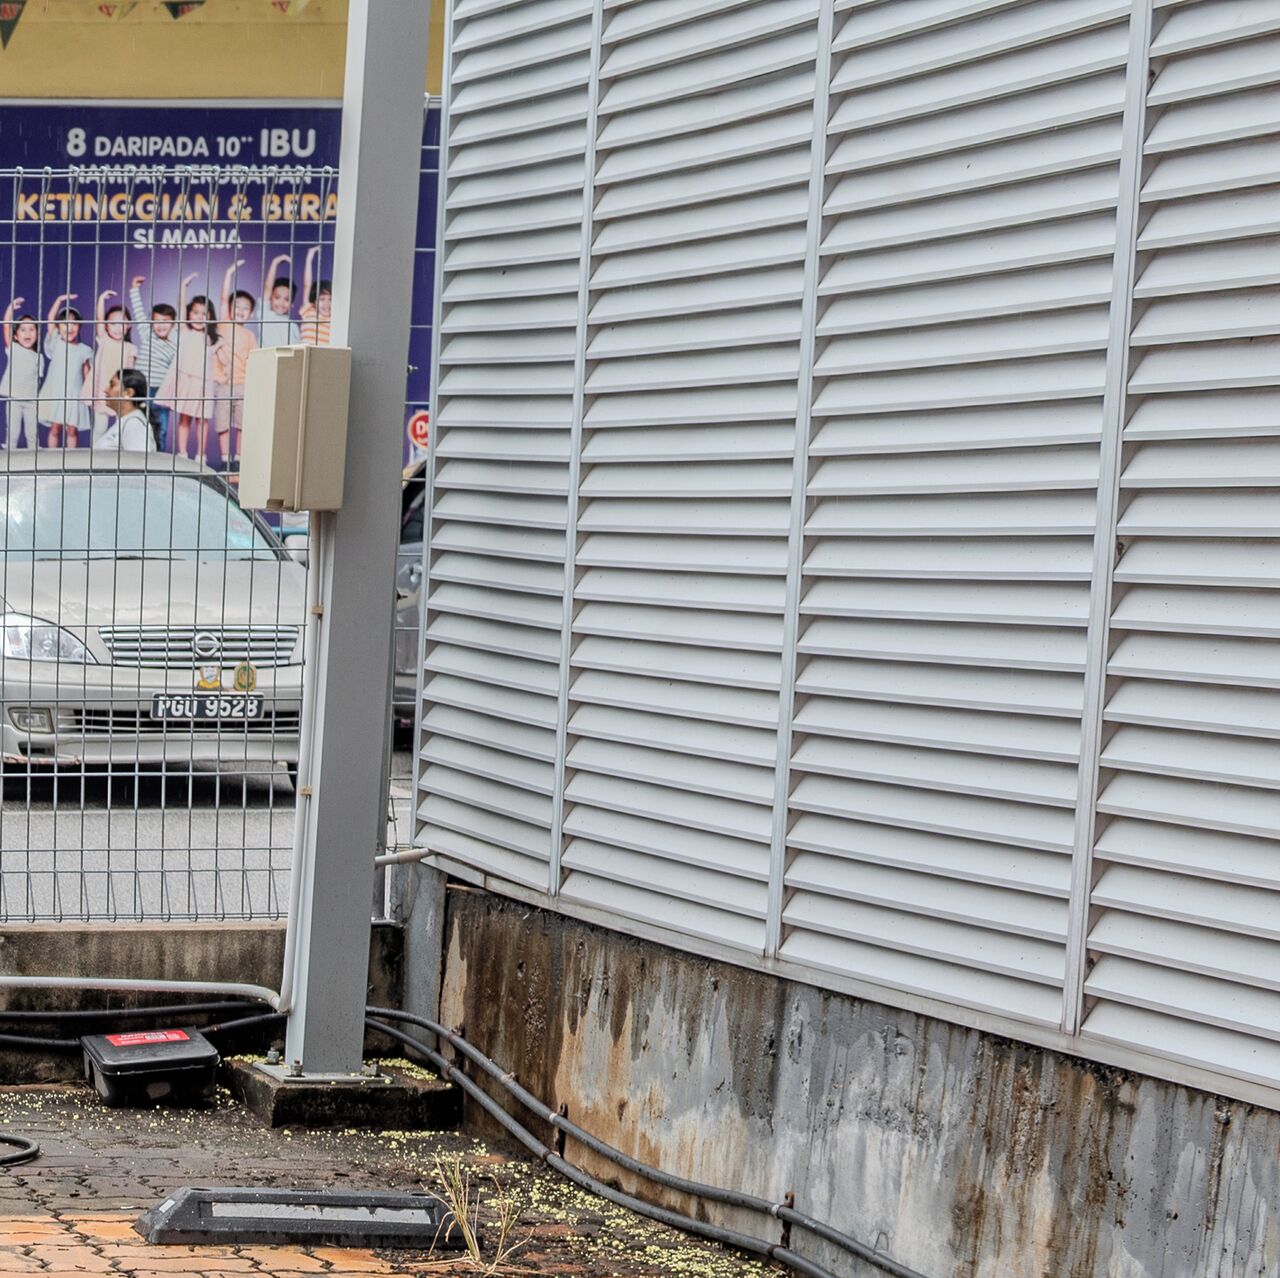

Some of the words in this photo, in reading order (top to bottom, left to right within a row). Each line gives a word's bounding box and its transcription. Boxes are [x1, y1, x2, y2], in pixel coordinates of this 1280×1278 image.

[67, 128, 87, 158] 8
[95, 136, 209, 157] DARIPADA
[260, 128, 316, 158] IBU
[16, 193, 219, 221] KETINGGIAN
[227, 194, 253, 221] &
[134, 228, 154, 249] SI
[161, 228, 243, 249] MANJA
[157, 696, 198, 717] PGU
[204, 696, 259, 717] 9528
